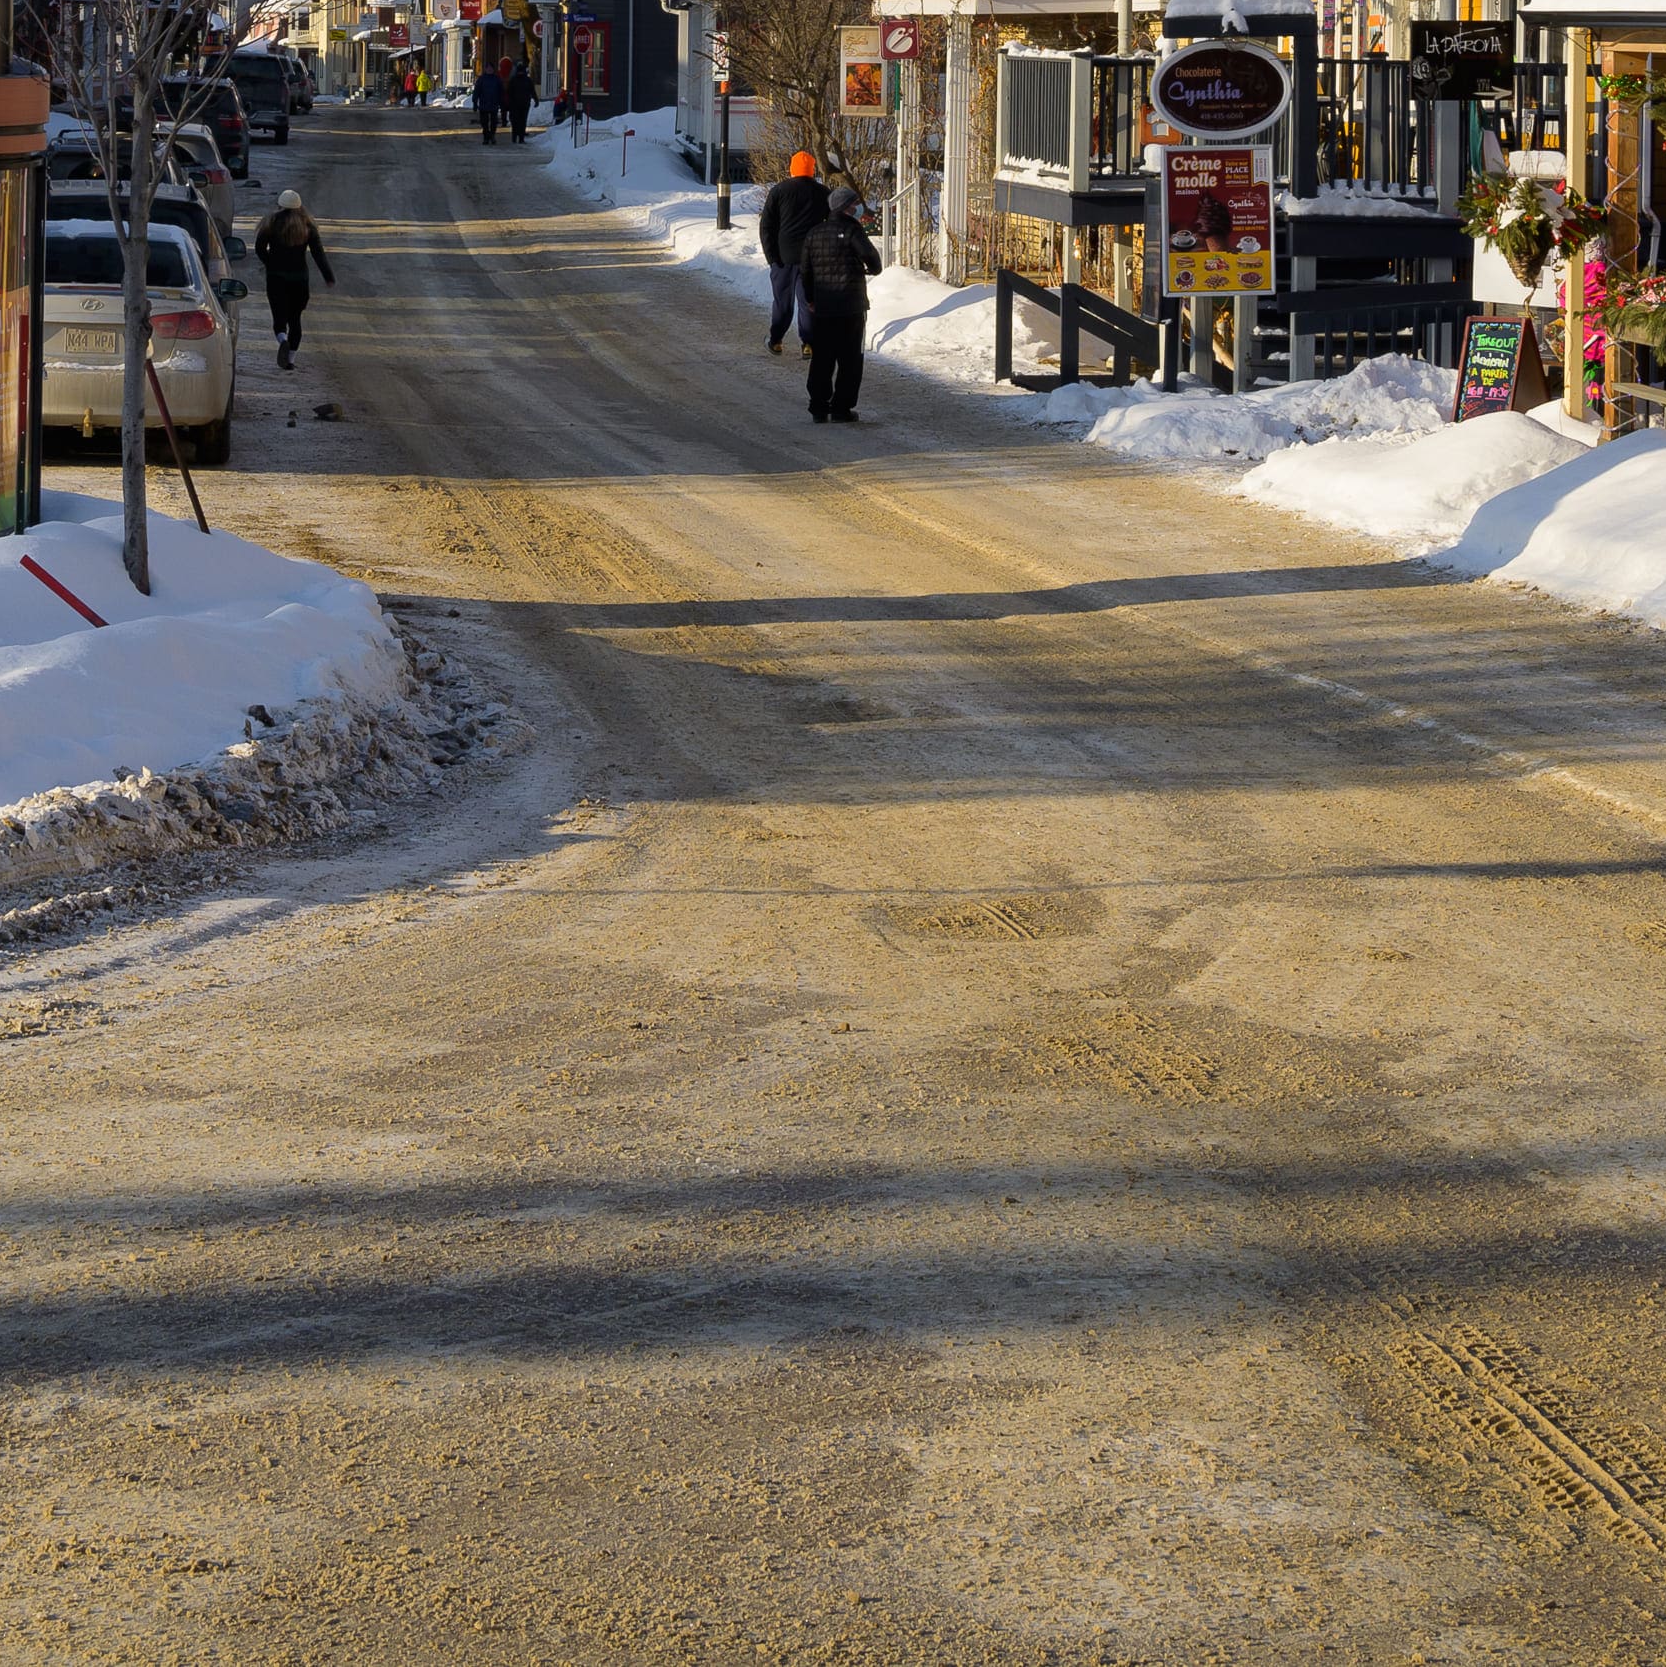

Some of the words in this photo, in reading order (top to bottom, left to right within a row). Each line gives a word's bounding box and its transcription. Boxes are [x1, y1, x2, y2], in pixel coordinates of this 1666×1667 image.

[1175, 66, 1222, 78] Chocolaterie
[1168, 78, 1244, 107] Cynthia
[1171, 155, 1222, 171] Crème
[1225, 166, 1249, 174] PLACE
[1174, 172, 1218, 188] molle
[67, 333, 88, 348] N44
[1476, 334, 1517, 349] TAKEOUT
